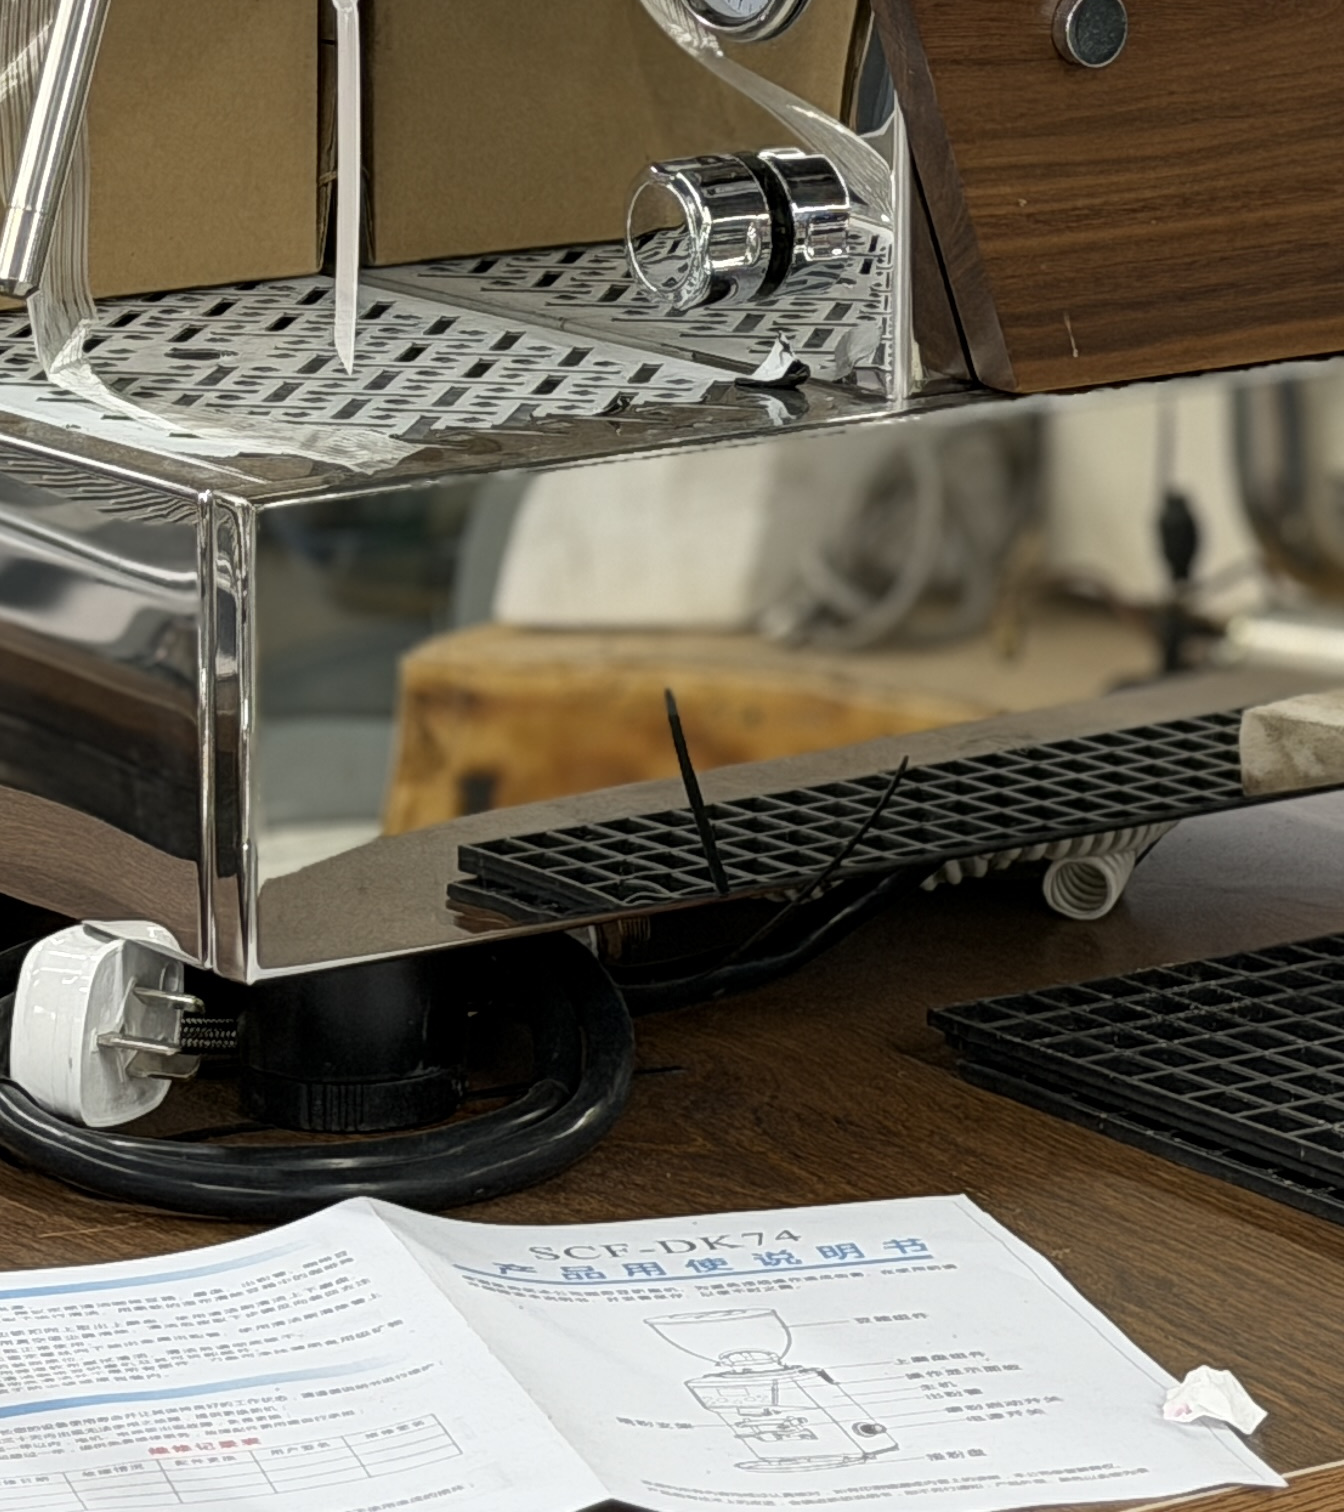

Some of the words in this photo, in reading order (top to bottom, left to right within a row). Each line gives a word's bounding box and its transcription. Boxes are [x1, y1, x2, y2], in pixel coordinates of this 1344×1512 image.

[491, 1237, 929, 1282] 产品用使说明书
[528, 1229, 804, 1262] SCF-DK74
